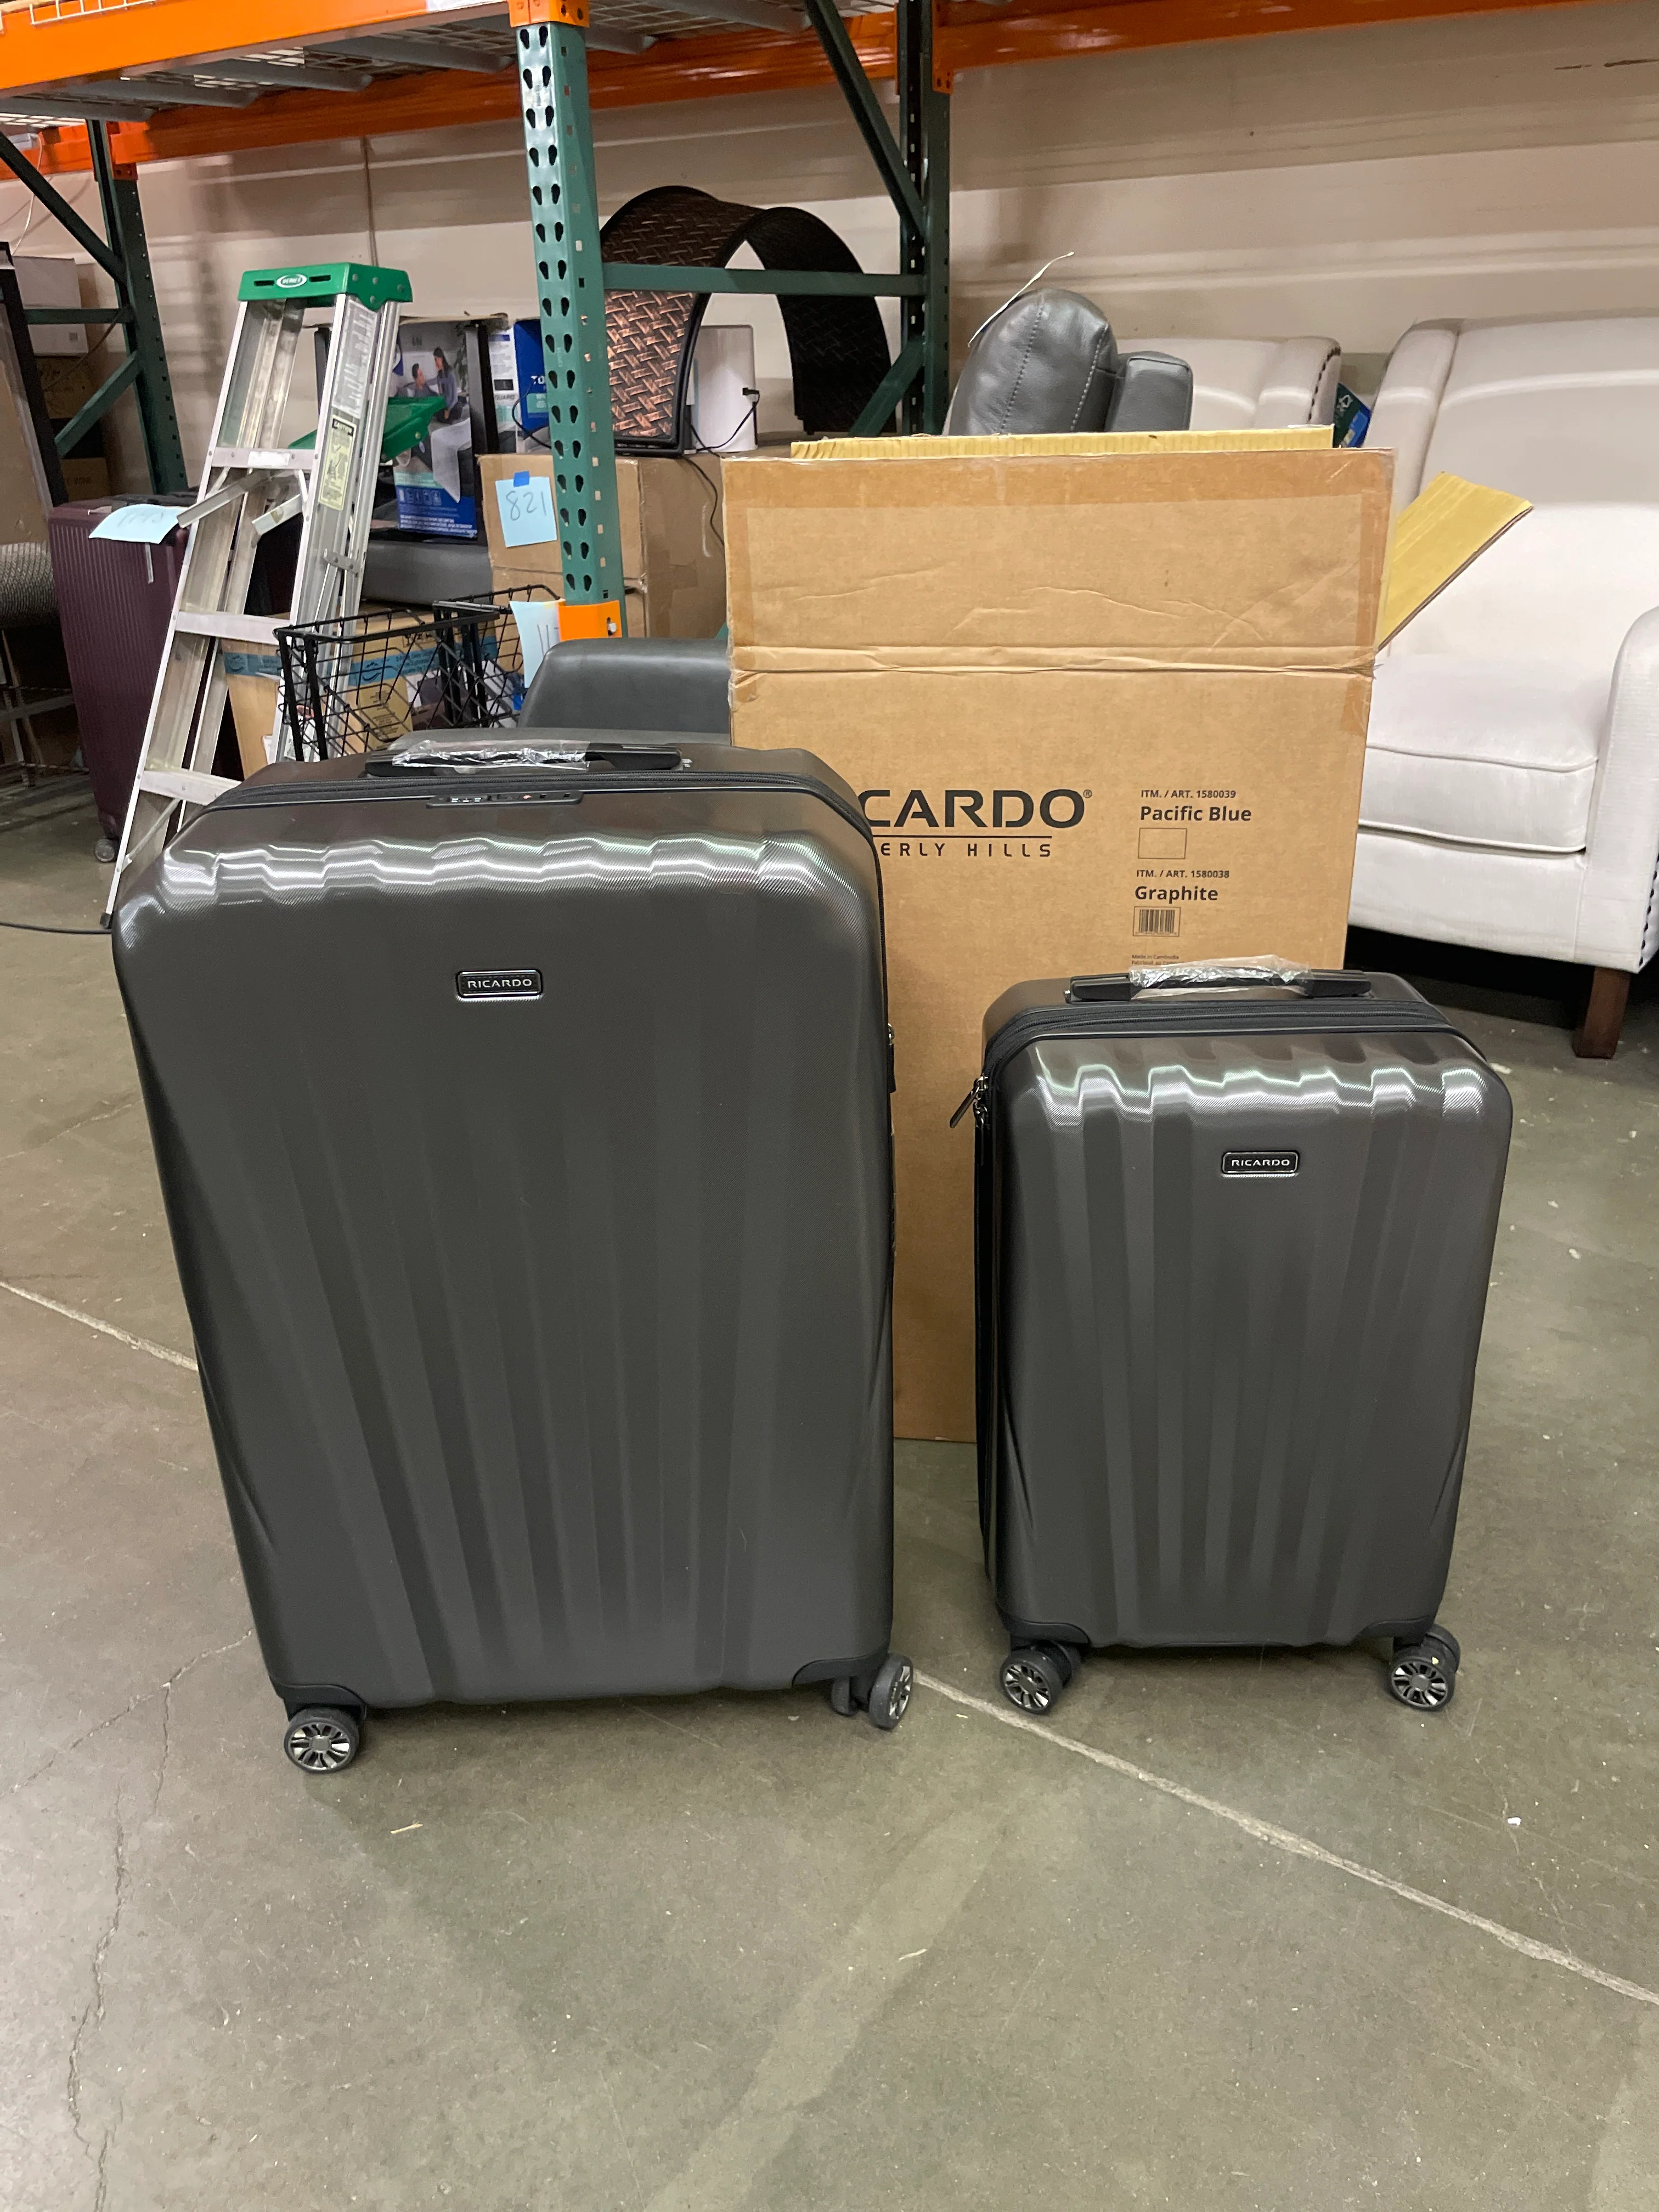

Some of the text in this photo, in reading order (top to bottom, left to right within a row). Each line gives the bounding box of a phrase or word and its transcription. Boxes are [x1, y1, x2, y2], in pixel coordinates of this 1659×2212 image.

[505, 490, 547, 521] 821
[1141, 789, 1162, 798] ITM.
[1170, 789, 1193, 799] ART.
[1196, 789, 1237, 799] 1580039
[857, 788, 1085, 829] CARDO
[1140, 805, 1252, 822] Pacific Blue
[880, 842, 1051, 857] ERLY HILLS
[1136, 870, 1157, 878] ITM.
[1166, 870, 1188, 878] ART.
[1190, 870, 1229, 878] 1580038
[1135, 885, 1218, 905] Graphite
[467, 979, 533, 988] RICARDO
[1231, 1159, 1290, 1167] RICARDO
